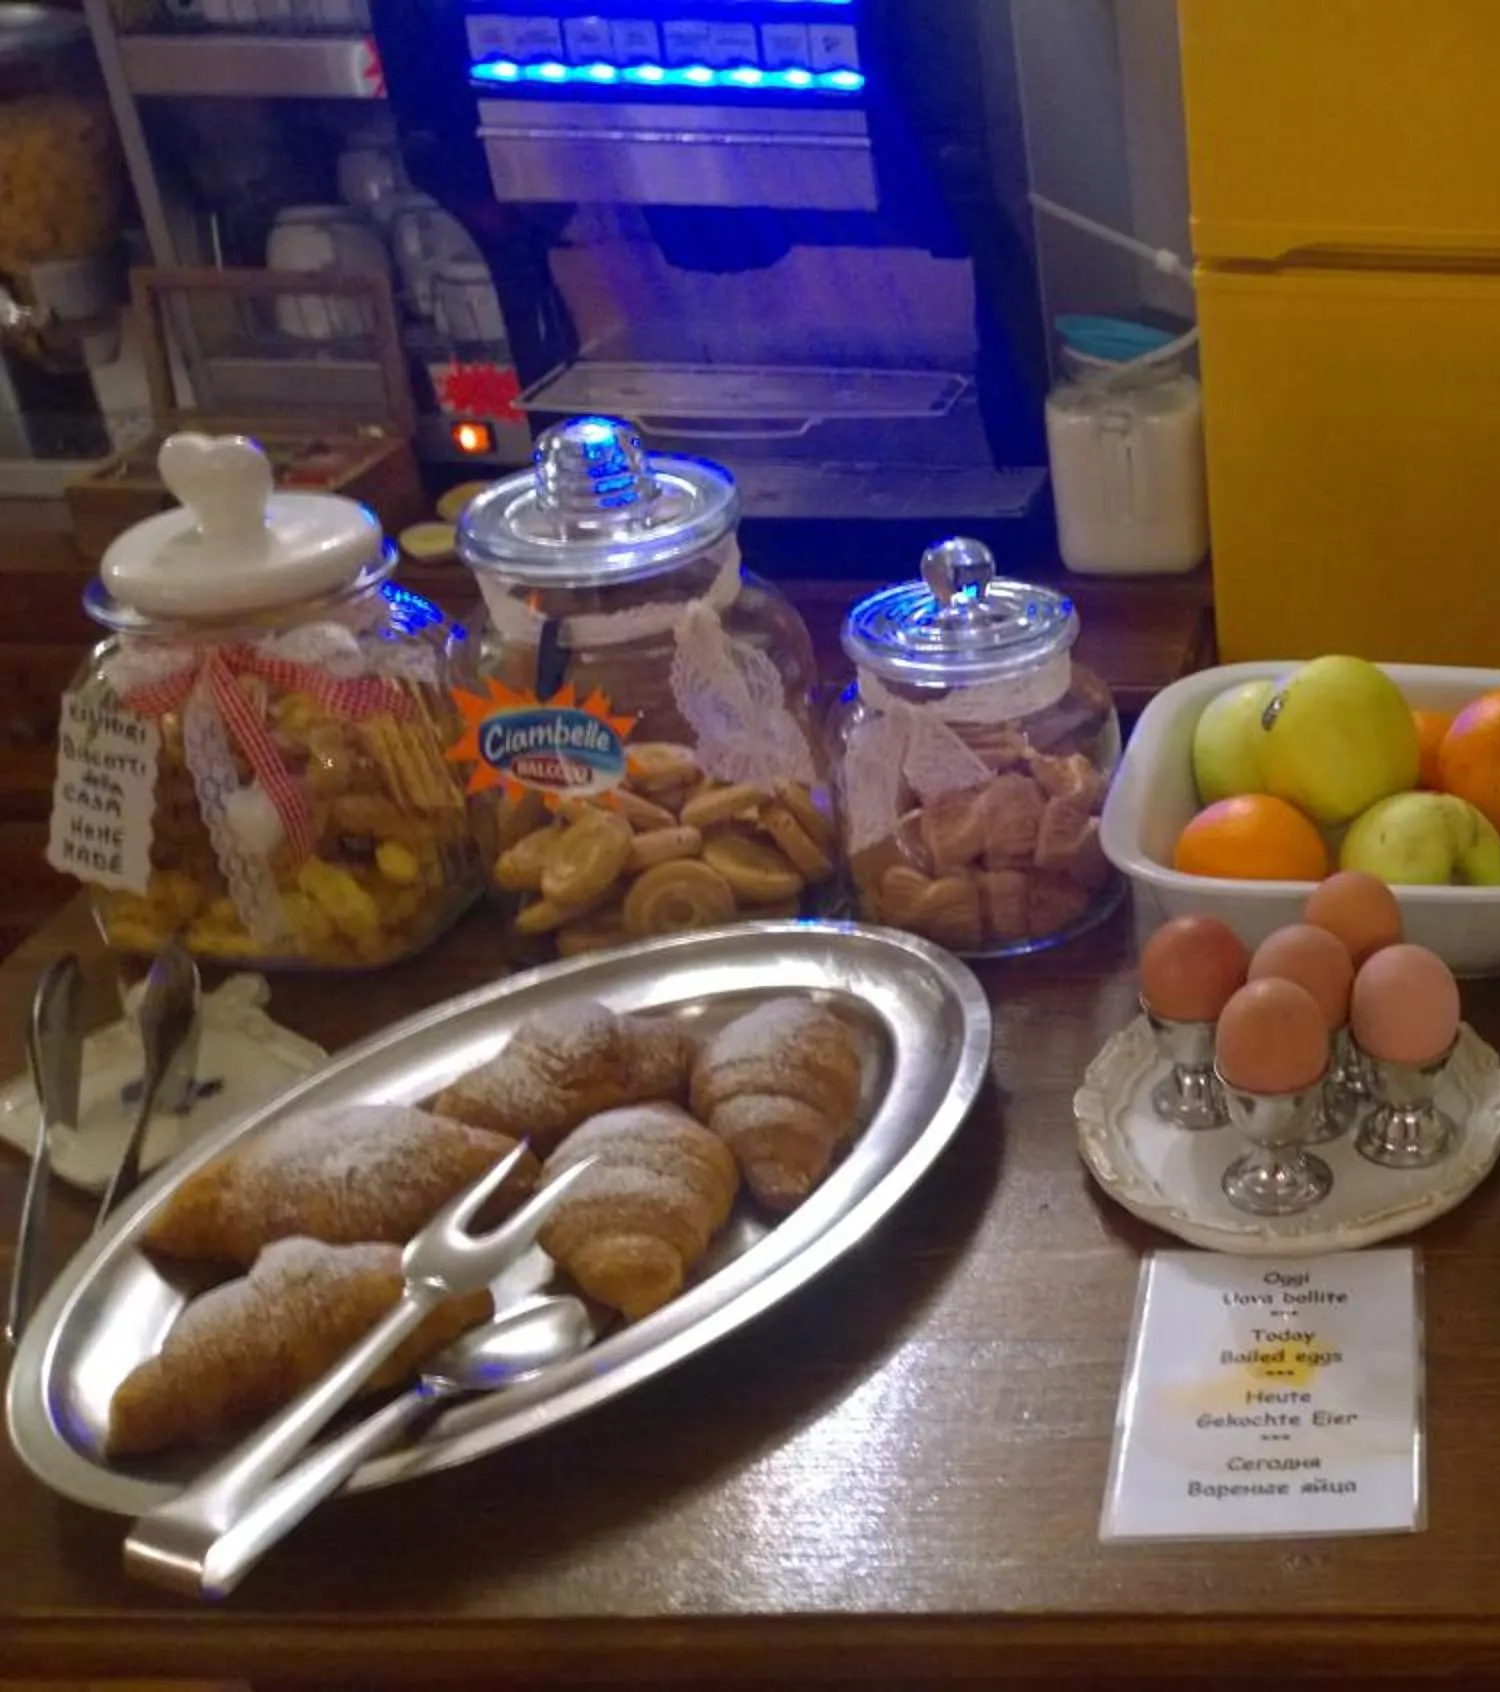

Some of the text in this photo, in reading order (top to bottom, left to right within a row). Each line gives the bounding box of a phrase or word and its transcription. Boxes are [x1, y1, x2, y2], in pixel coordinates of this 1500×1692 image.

[484, 714, 611, 762] Ciambelle
[1263, 1271, 1310, 1287] Oggi
[1282, 1290, 1349, 1304] bollite
[1251, 1328, 1316, 1345] Today
[1295, 1351, 1343, 1366] eggs
[1246, 1390, 1312, 1404] Heute
[1196, 1410, 1358, 1428] Gekochte Eier
